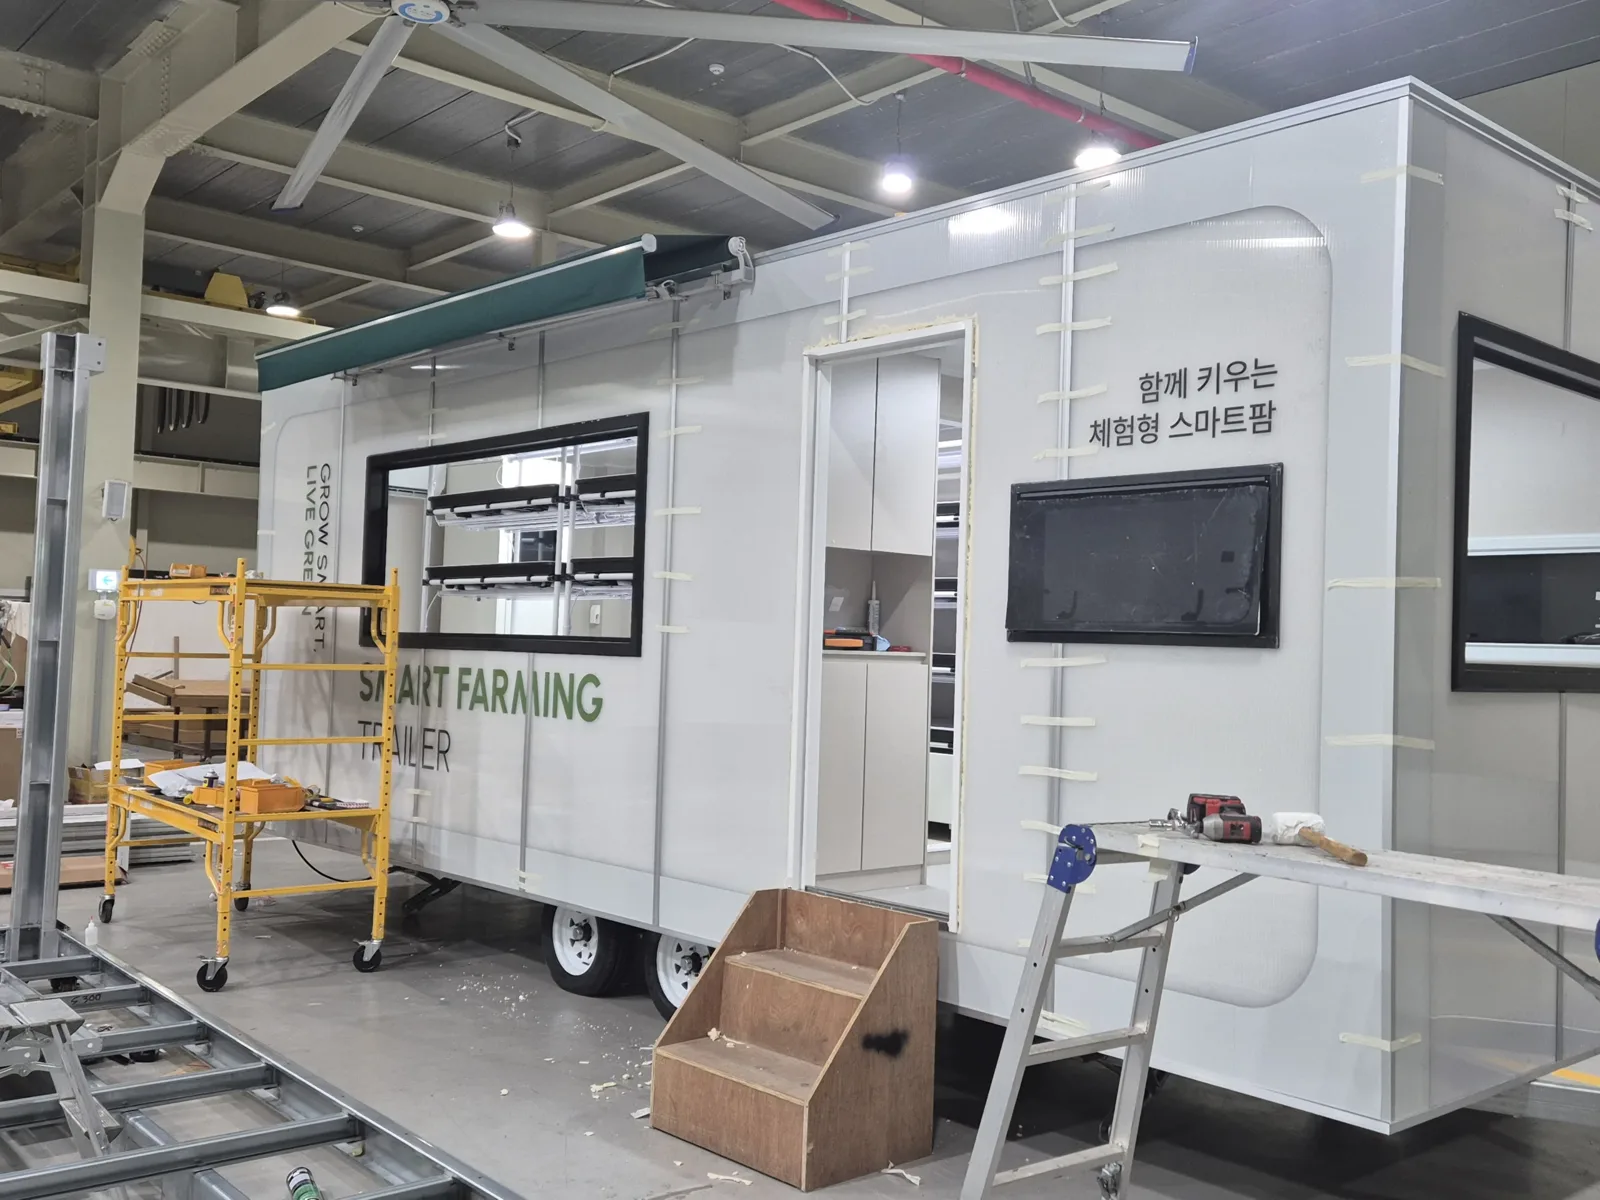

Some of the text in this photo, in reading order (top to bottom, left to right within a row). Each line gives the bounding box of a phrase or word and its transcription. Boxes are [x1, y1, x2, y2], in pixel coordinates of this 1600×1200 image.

[1139, 358, 1278, 404] 함께 키우는
[1089, 400, 1277, 448] 체험형 스마트팜
[317, 463, 331, 545] GROW
[302, 465, 317, 616] LIVE GREN
[456, 667, 603, 722] FARMING
